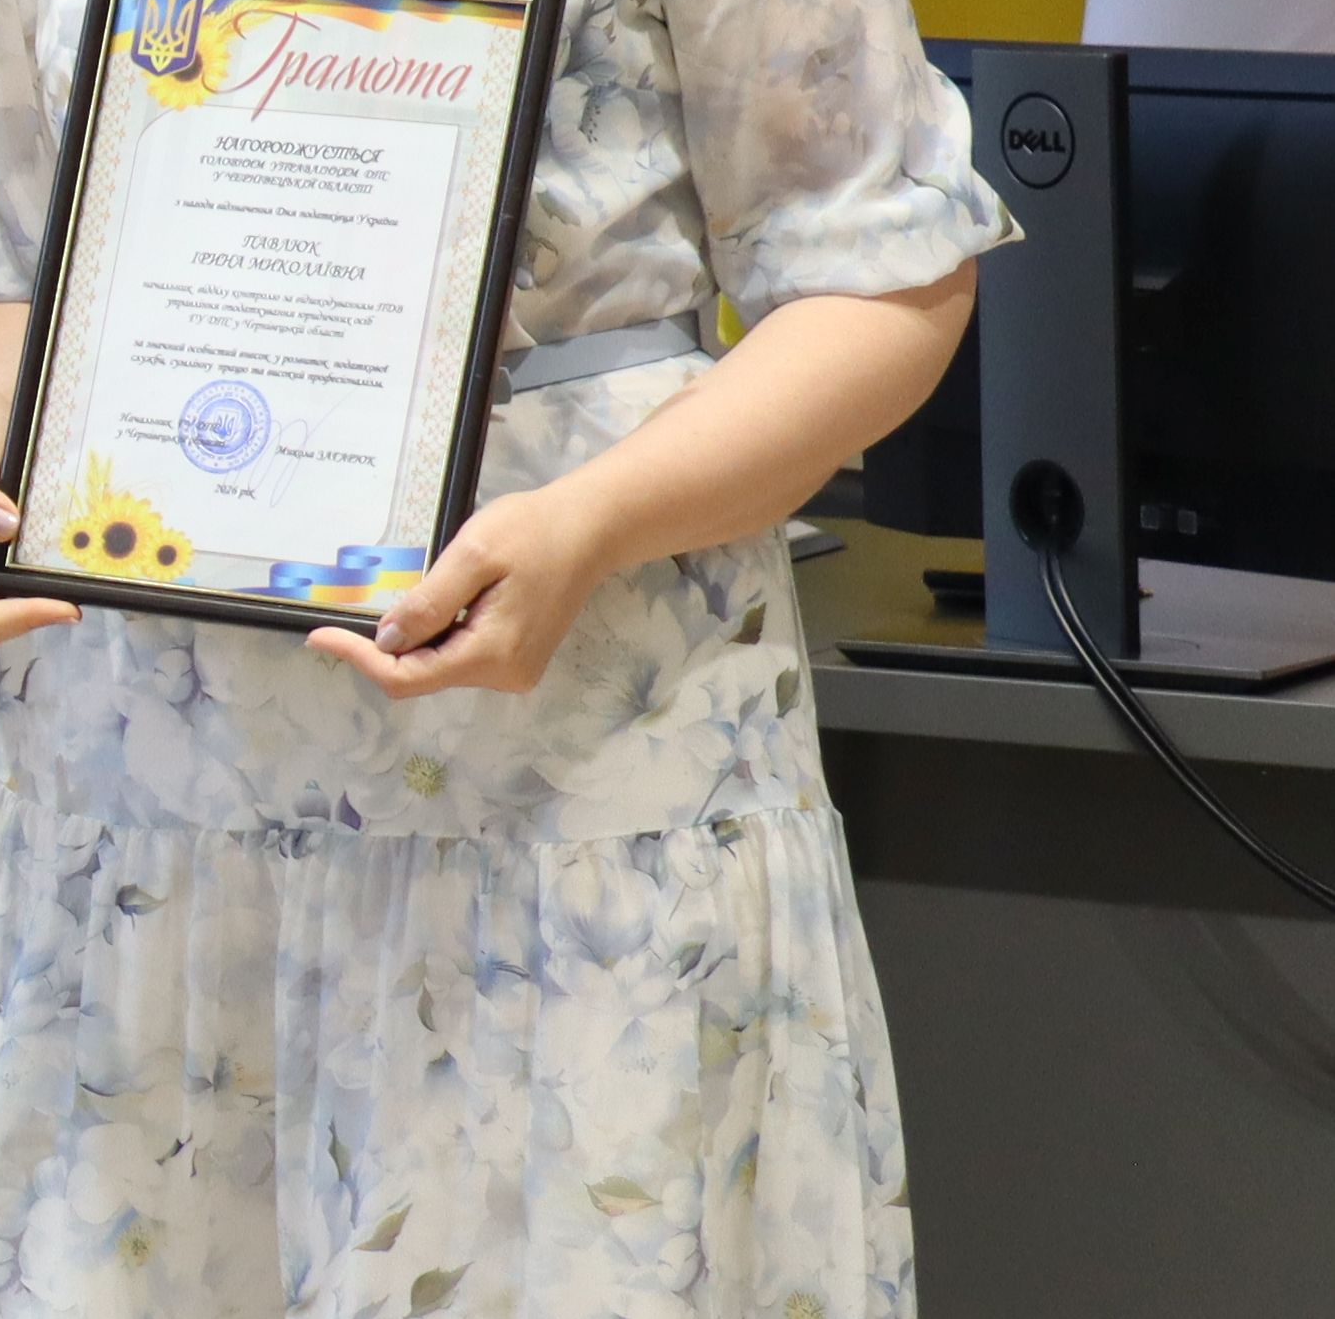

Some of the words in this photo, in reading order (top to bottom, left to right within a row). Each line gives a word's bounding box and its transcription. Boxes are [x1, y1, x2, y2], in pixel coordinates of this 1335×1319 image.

[201, 9, 474, 122] Грамота
[214, 136, 386, 164] НАГОРОДЖУЄТЬСЯ
[1008, 129, 1066, 154] DELL
[318, 181, 374, 194] ОБЛАСТІ
[275, 206, 297, 217] Дня
[357, 213, 399, 228] України
[242, 235, 323, 257] ПАВЛЮК
[191, 250, 244, 268] ІРИНА
[247, 257, 367, 281] МИКОЛАЇВНА
